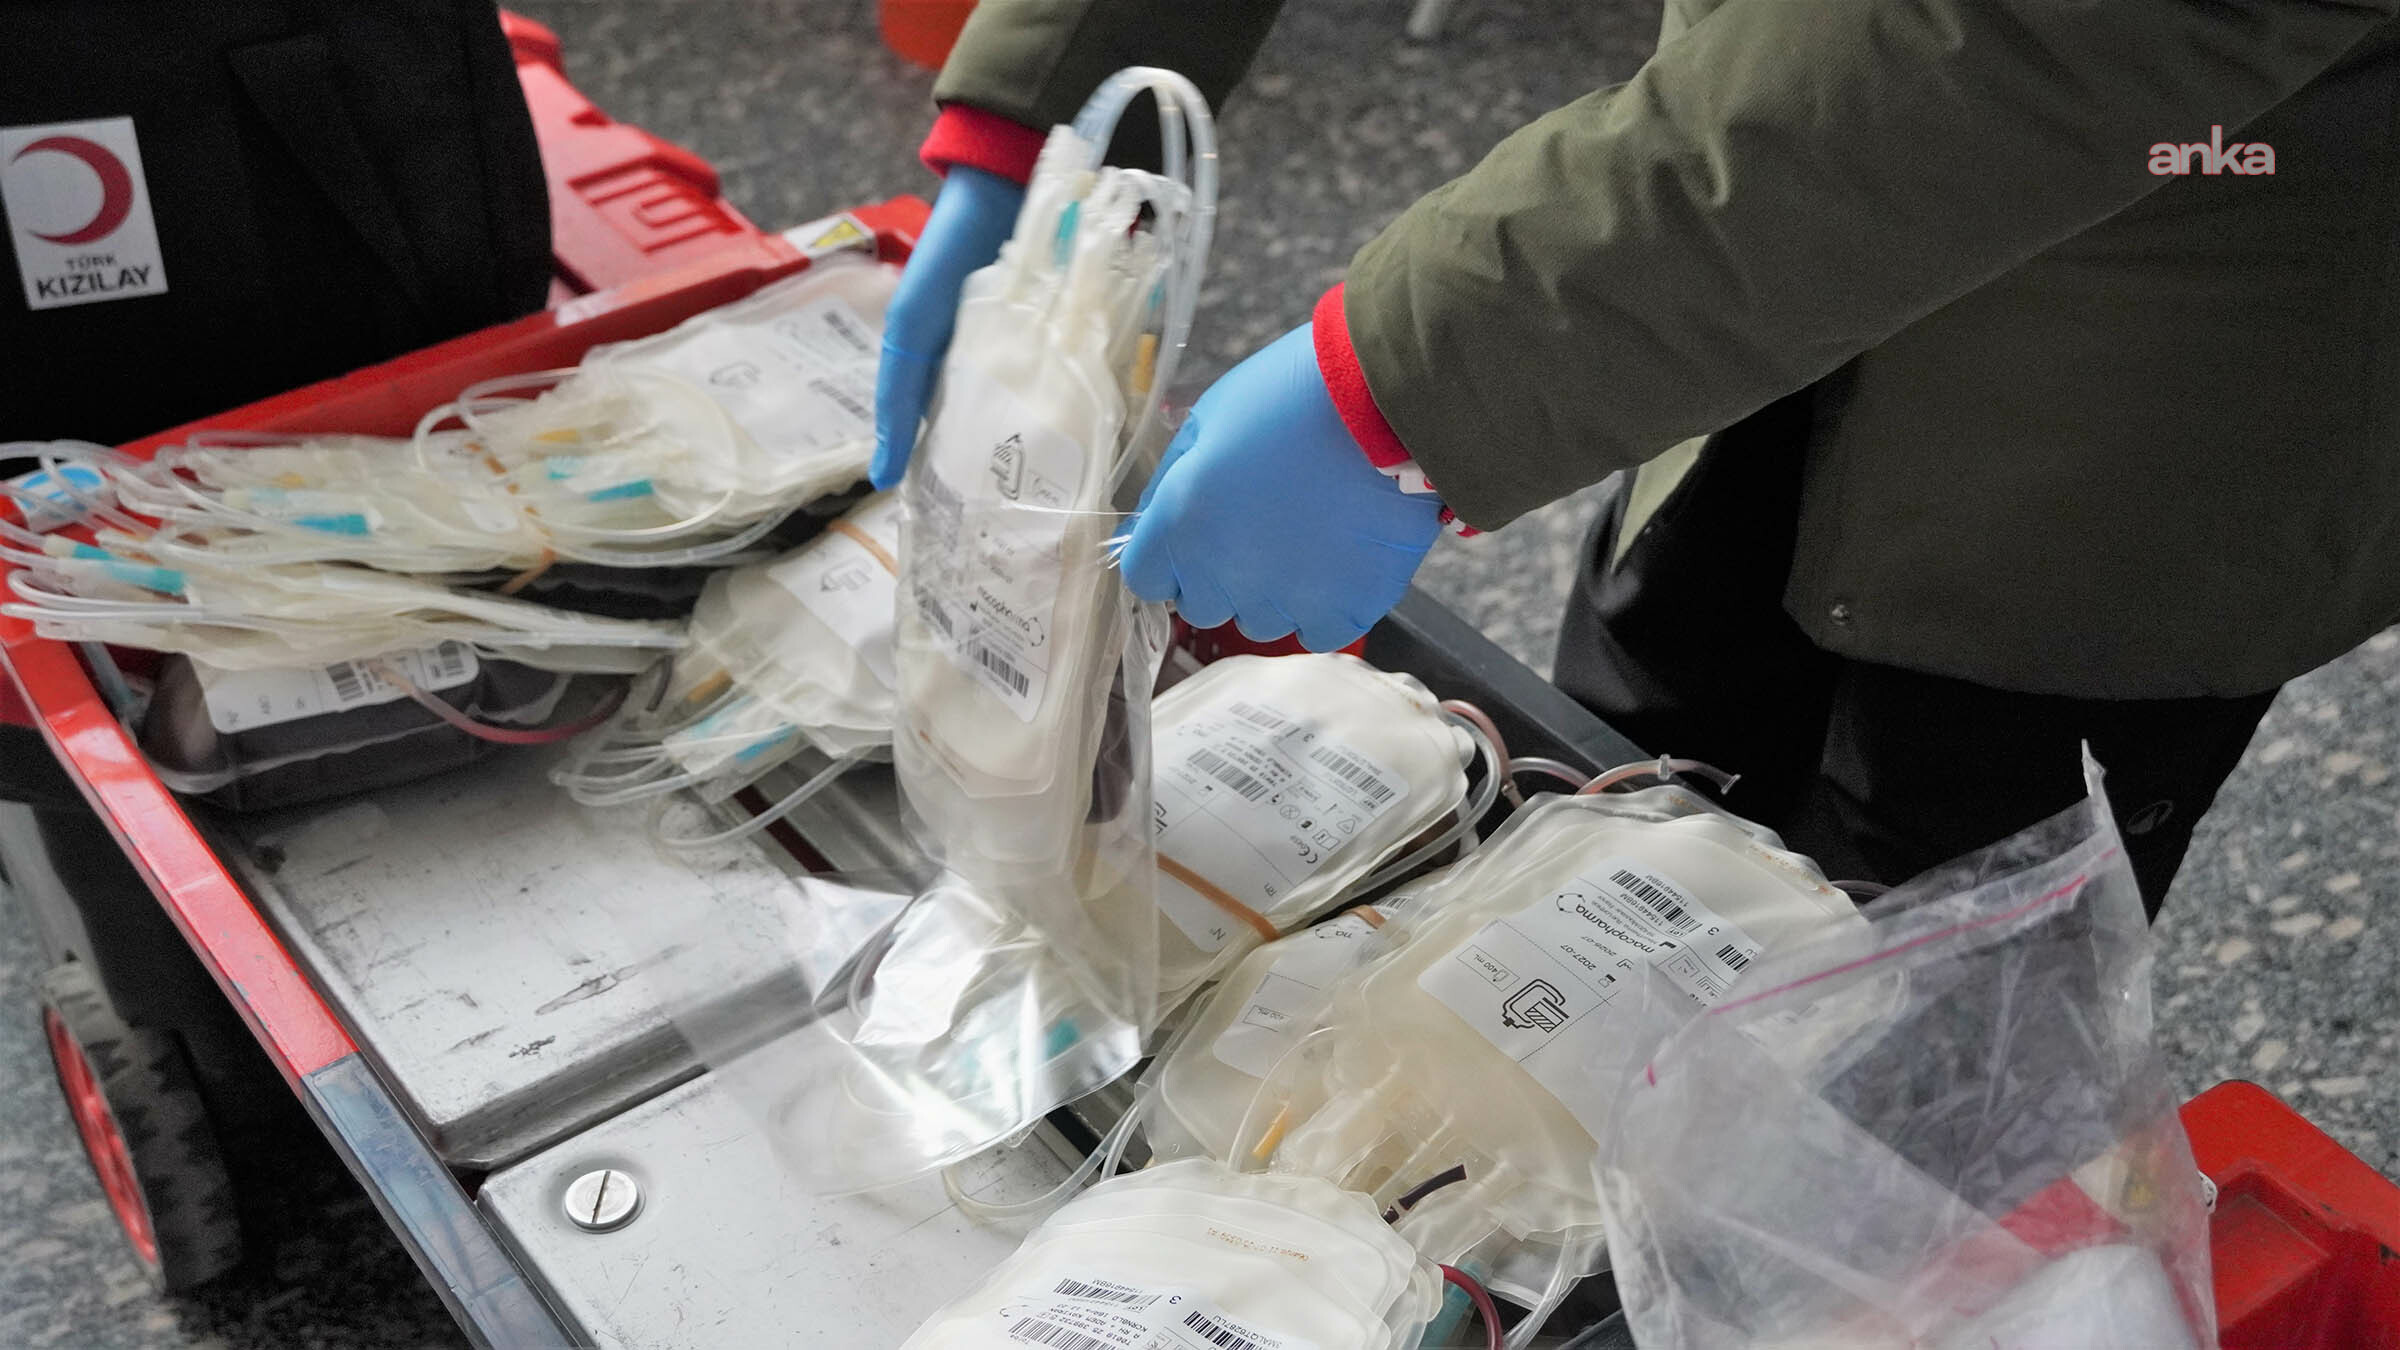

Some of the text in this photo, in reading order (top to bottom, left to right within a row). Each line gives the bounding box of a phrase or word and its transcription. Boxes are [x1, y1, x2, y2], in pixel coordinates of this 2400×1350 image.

[37, 265, 151, 299] KIZILAY
[1575, 904, 1655, 953] macopharma
[1707, 926, 1720, 936] 3
[1474, 954, 1498, 973] 400 mL
[1560, 945, 1597, 970] 2027-07
[1169, 1295, 1182, 1305] 3
